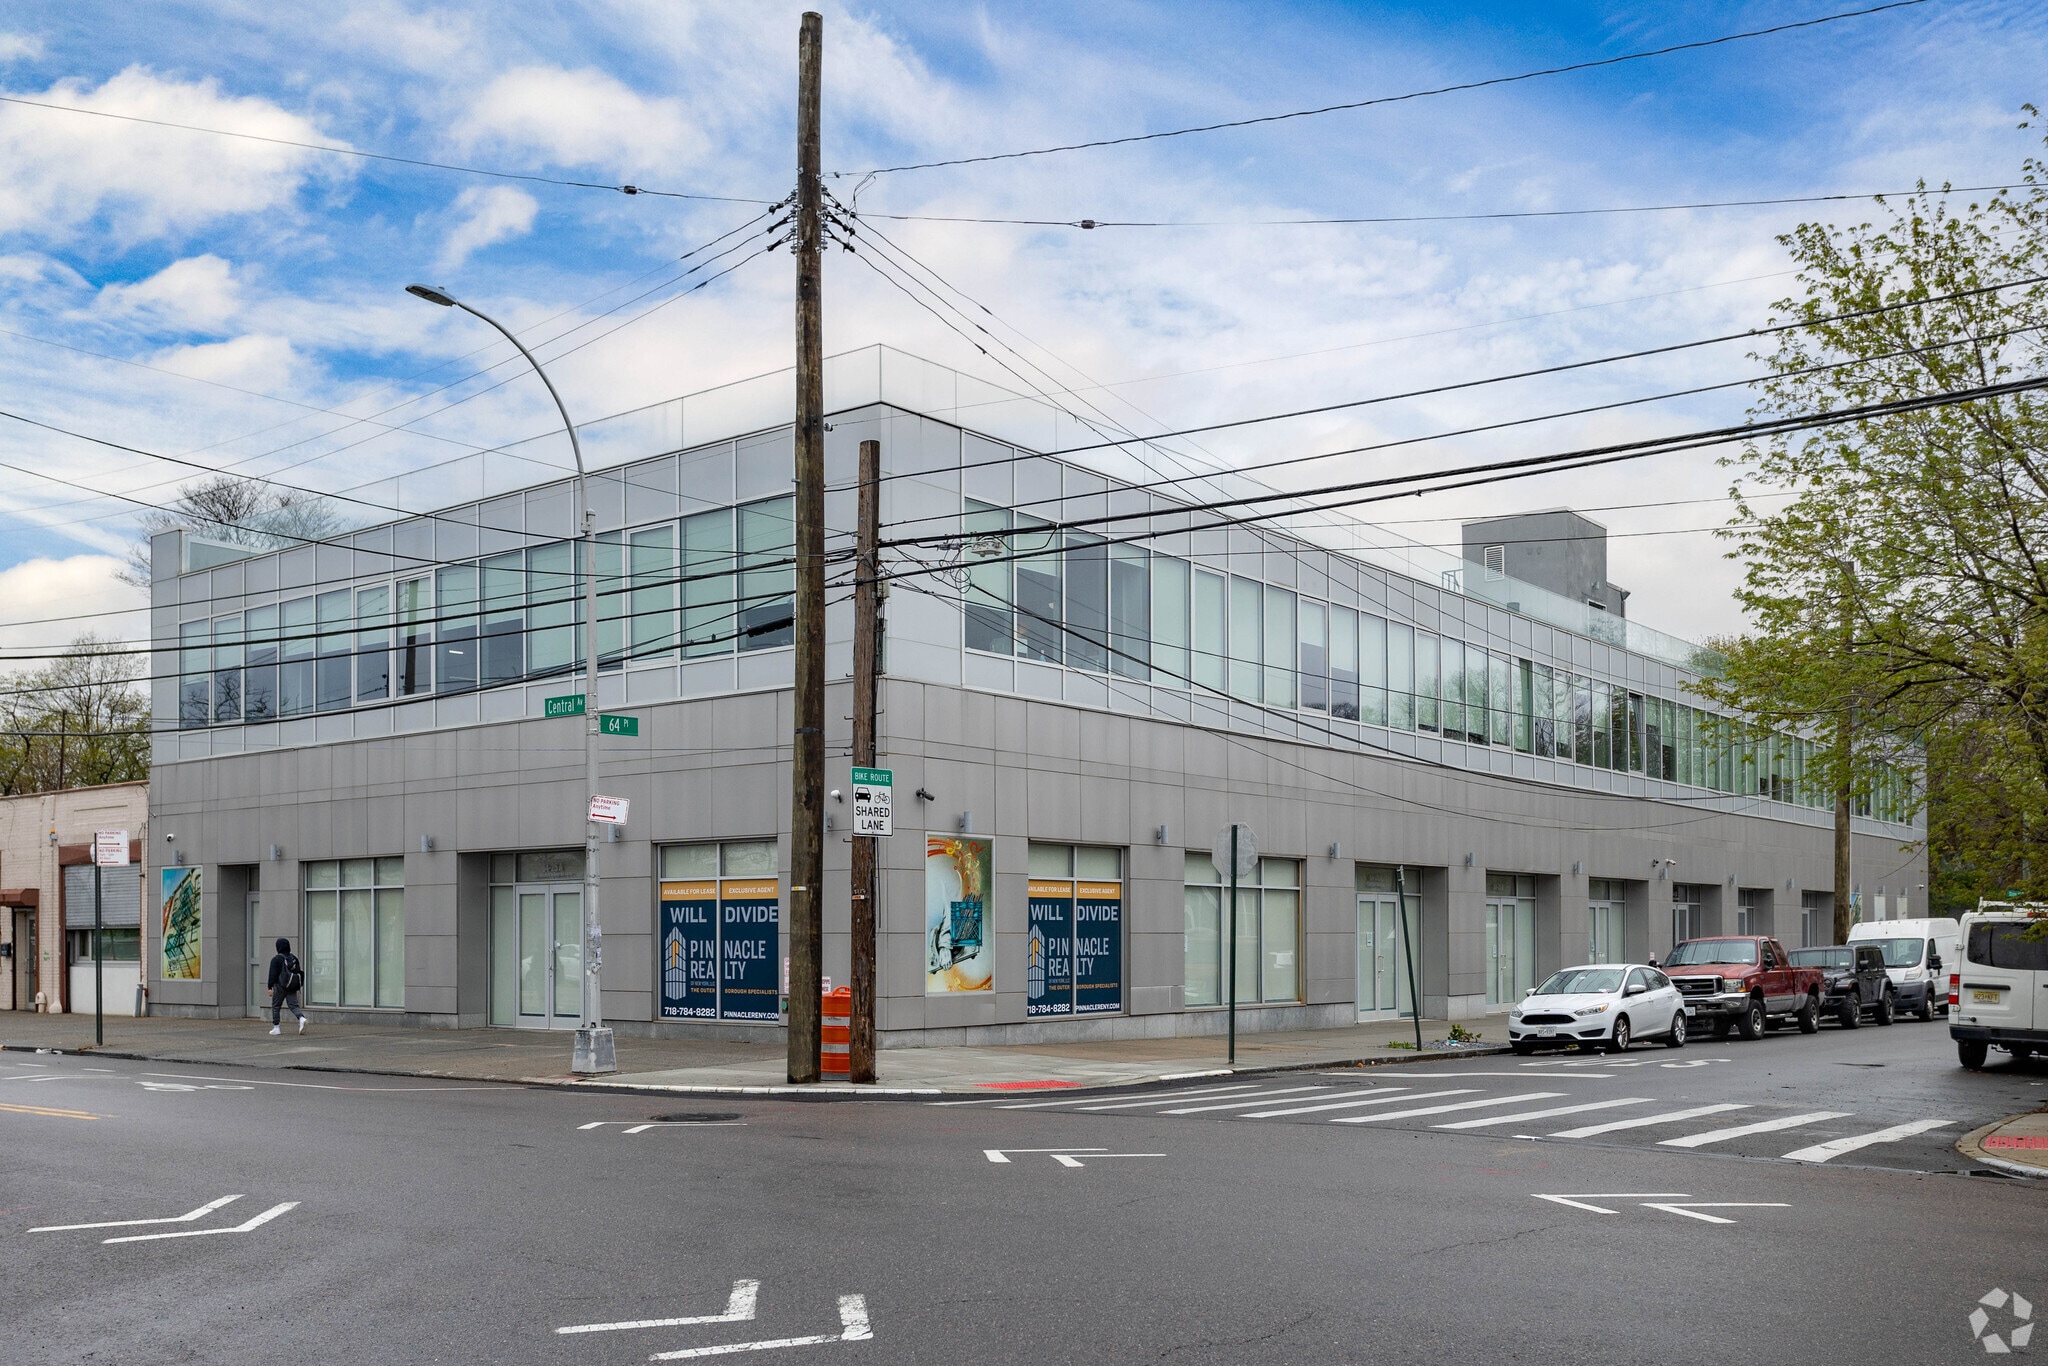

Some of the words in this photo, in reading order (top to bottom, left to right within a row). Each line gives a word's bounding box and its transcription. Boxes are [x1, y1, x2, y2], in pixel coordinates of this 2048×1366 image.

[548, 698, 574, 714] Central
[577, 697, 583, 706] Av
[608, 718, 620, 732] 64
[854, 772, 868, 781] BIKE
[870, 773, 890, 782] ROUTE
[855, 805, 890, 818] SHARED
[861, 820, 884, 831] LANE
[670, 907, 707, 923] WILL
[725, 906, 778, 923] DIVIDE
[1030, 904, 1063, 921] WILL
[1076, 905, 1119, 922] DIVIDE
[664, 1006, 716, 1017] 718-784-8282
